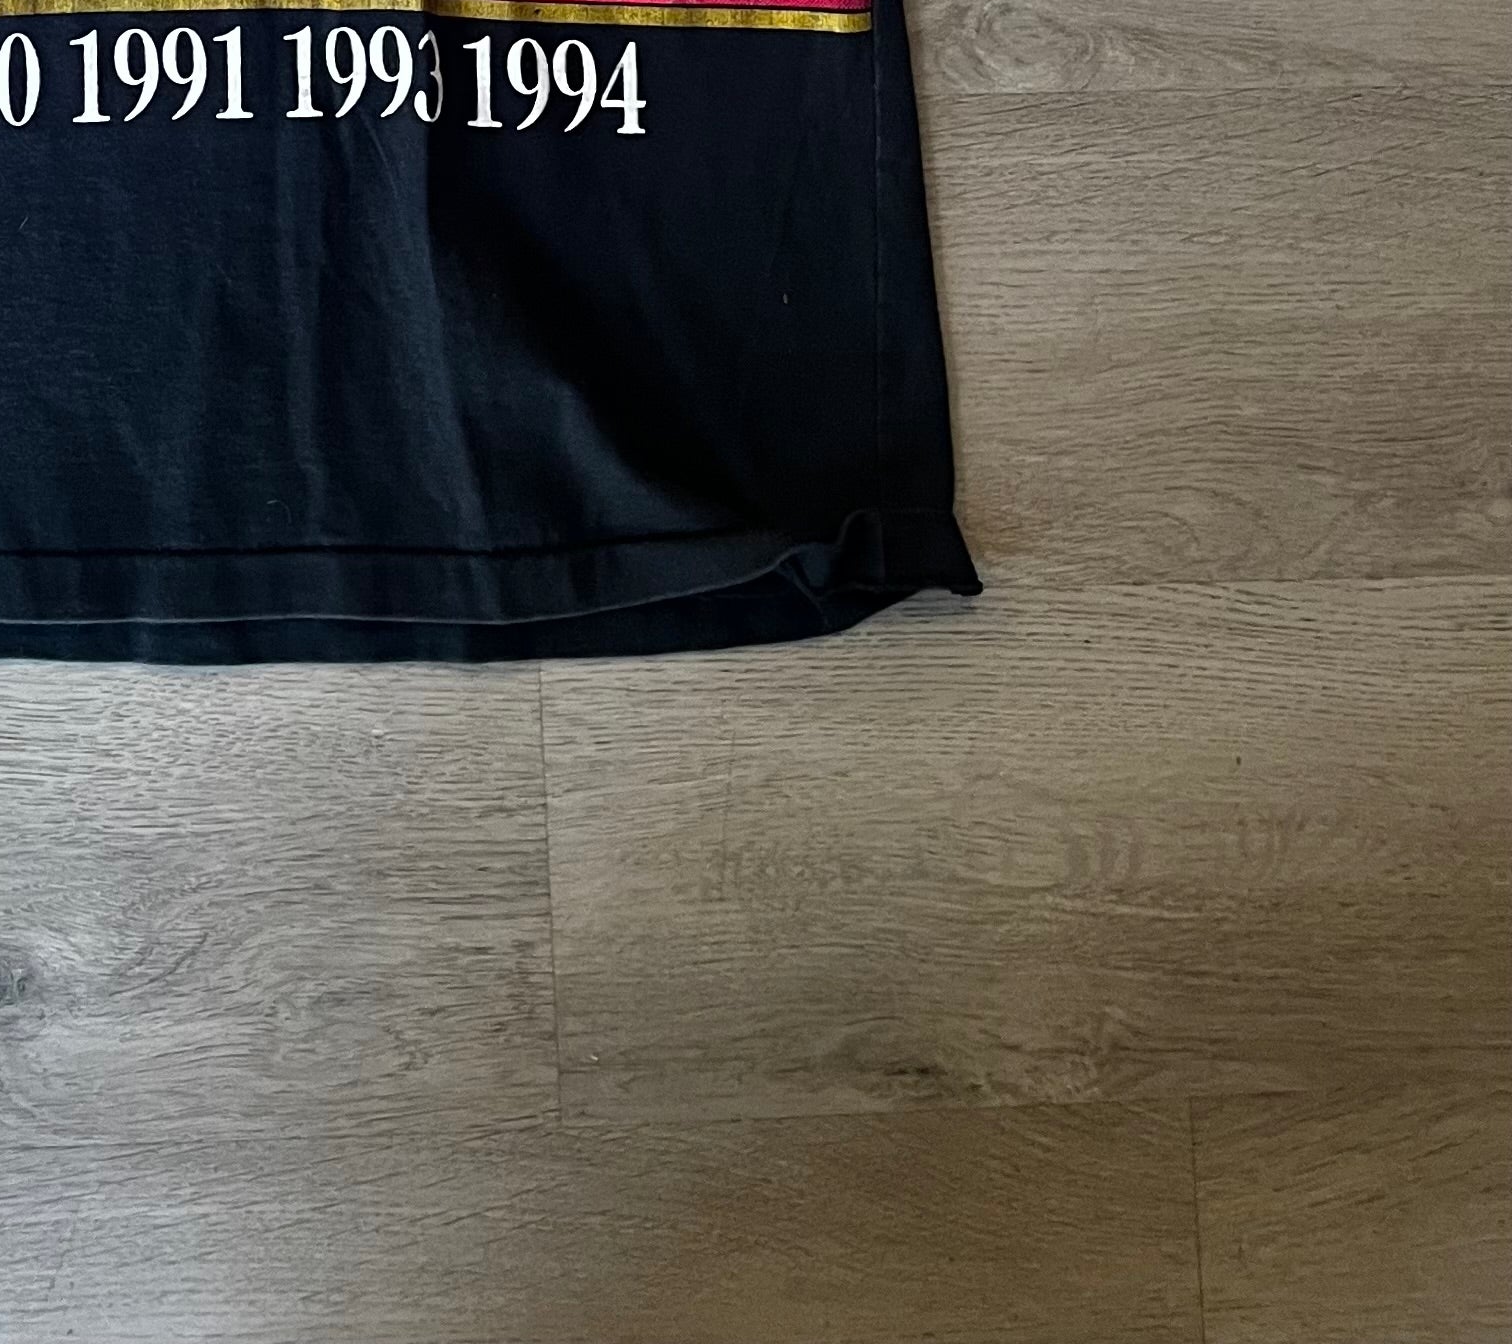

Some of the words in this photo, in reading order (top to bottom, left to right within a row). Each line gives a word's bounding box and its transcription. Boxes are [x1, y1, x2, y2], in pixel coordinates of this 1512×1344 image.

[69, 25, 254, 125] 1991
[282, 25, 444, 123] 1993
[464, 35, 648, 135] 1994
